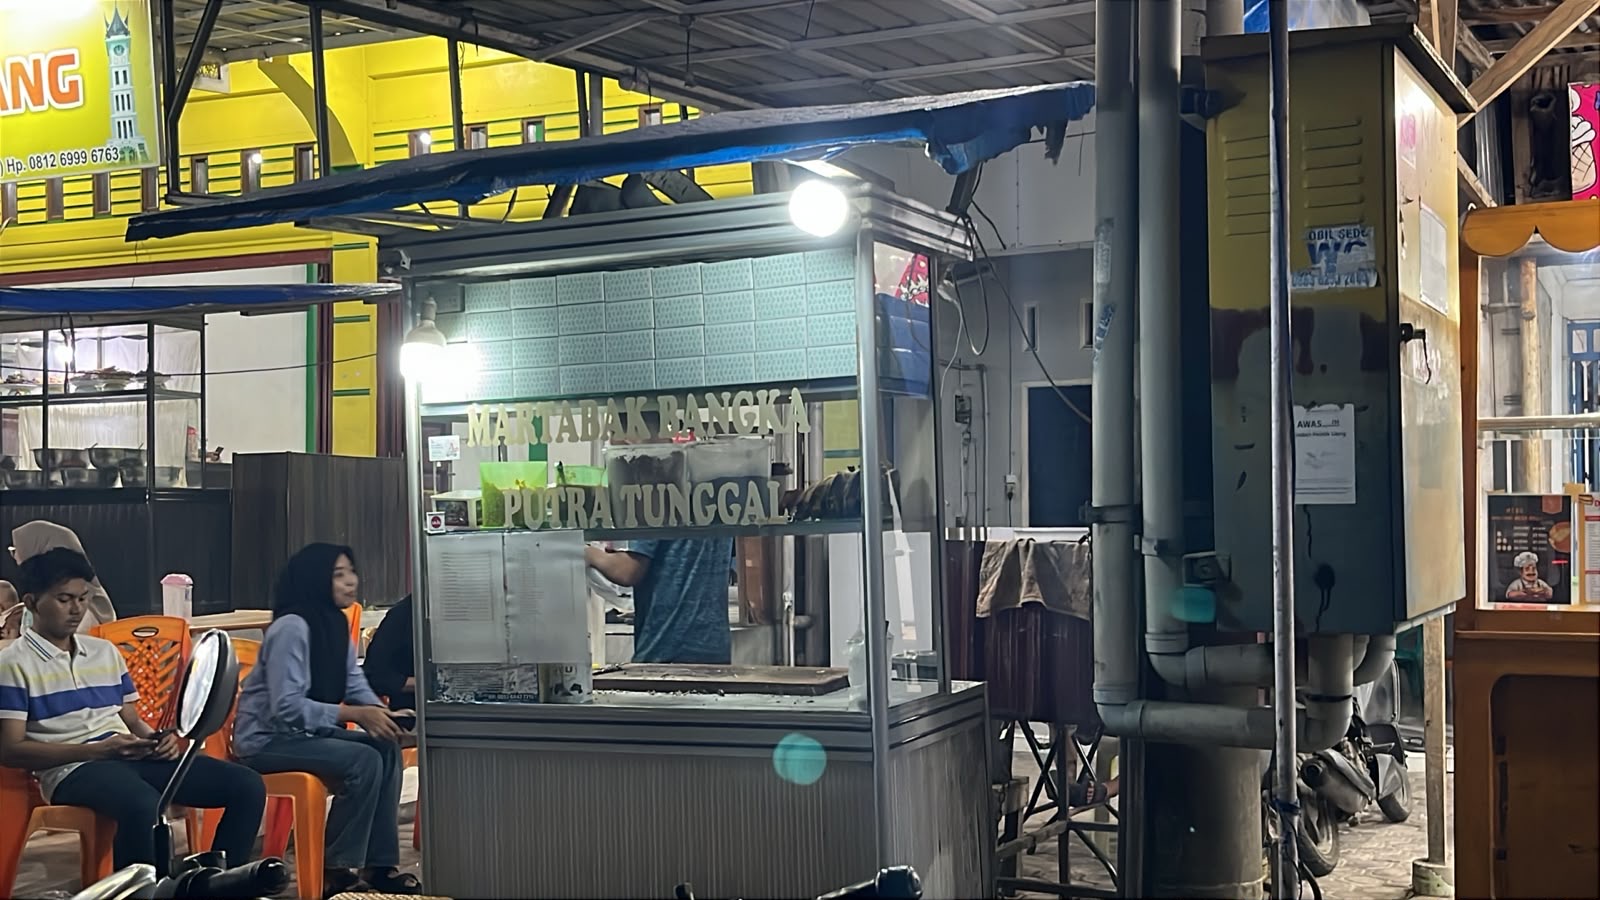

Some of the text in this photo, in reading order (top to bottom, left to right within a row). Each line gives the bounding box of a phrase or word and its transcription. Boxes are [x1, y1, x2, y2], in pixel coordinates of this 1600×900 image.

[7, 159, 25, 174] Hp.
[30, 154, 56, 169] 0812
[60, 151, 87, 166] 6999
[91, 147, 119, 162] 6763
[467, 387, 811, 447] MARTABAK BANGKA
[502, 480, 789, 530] PUTRA TUNGGAL
